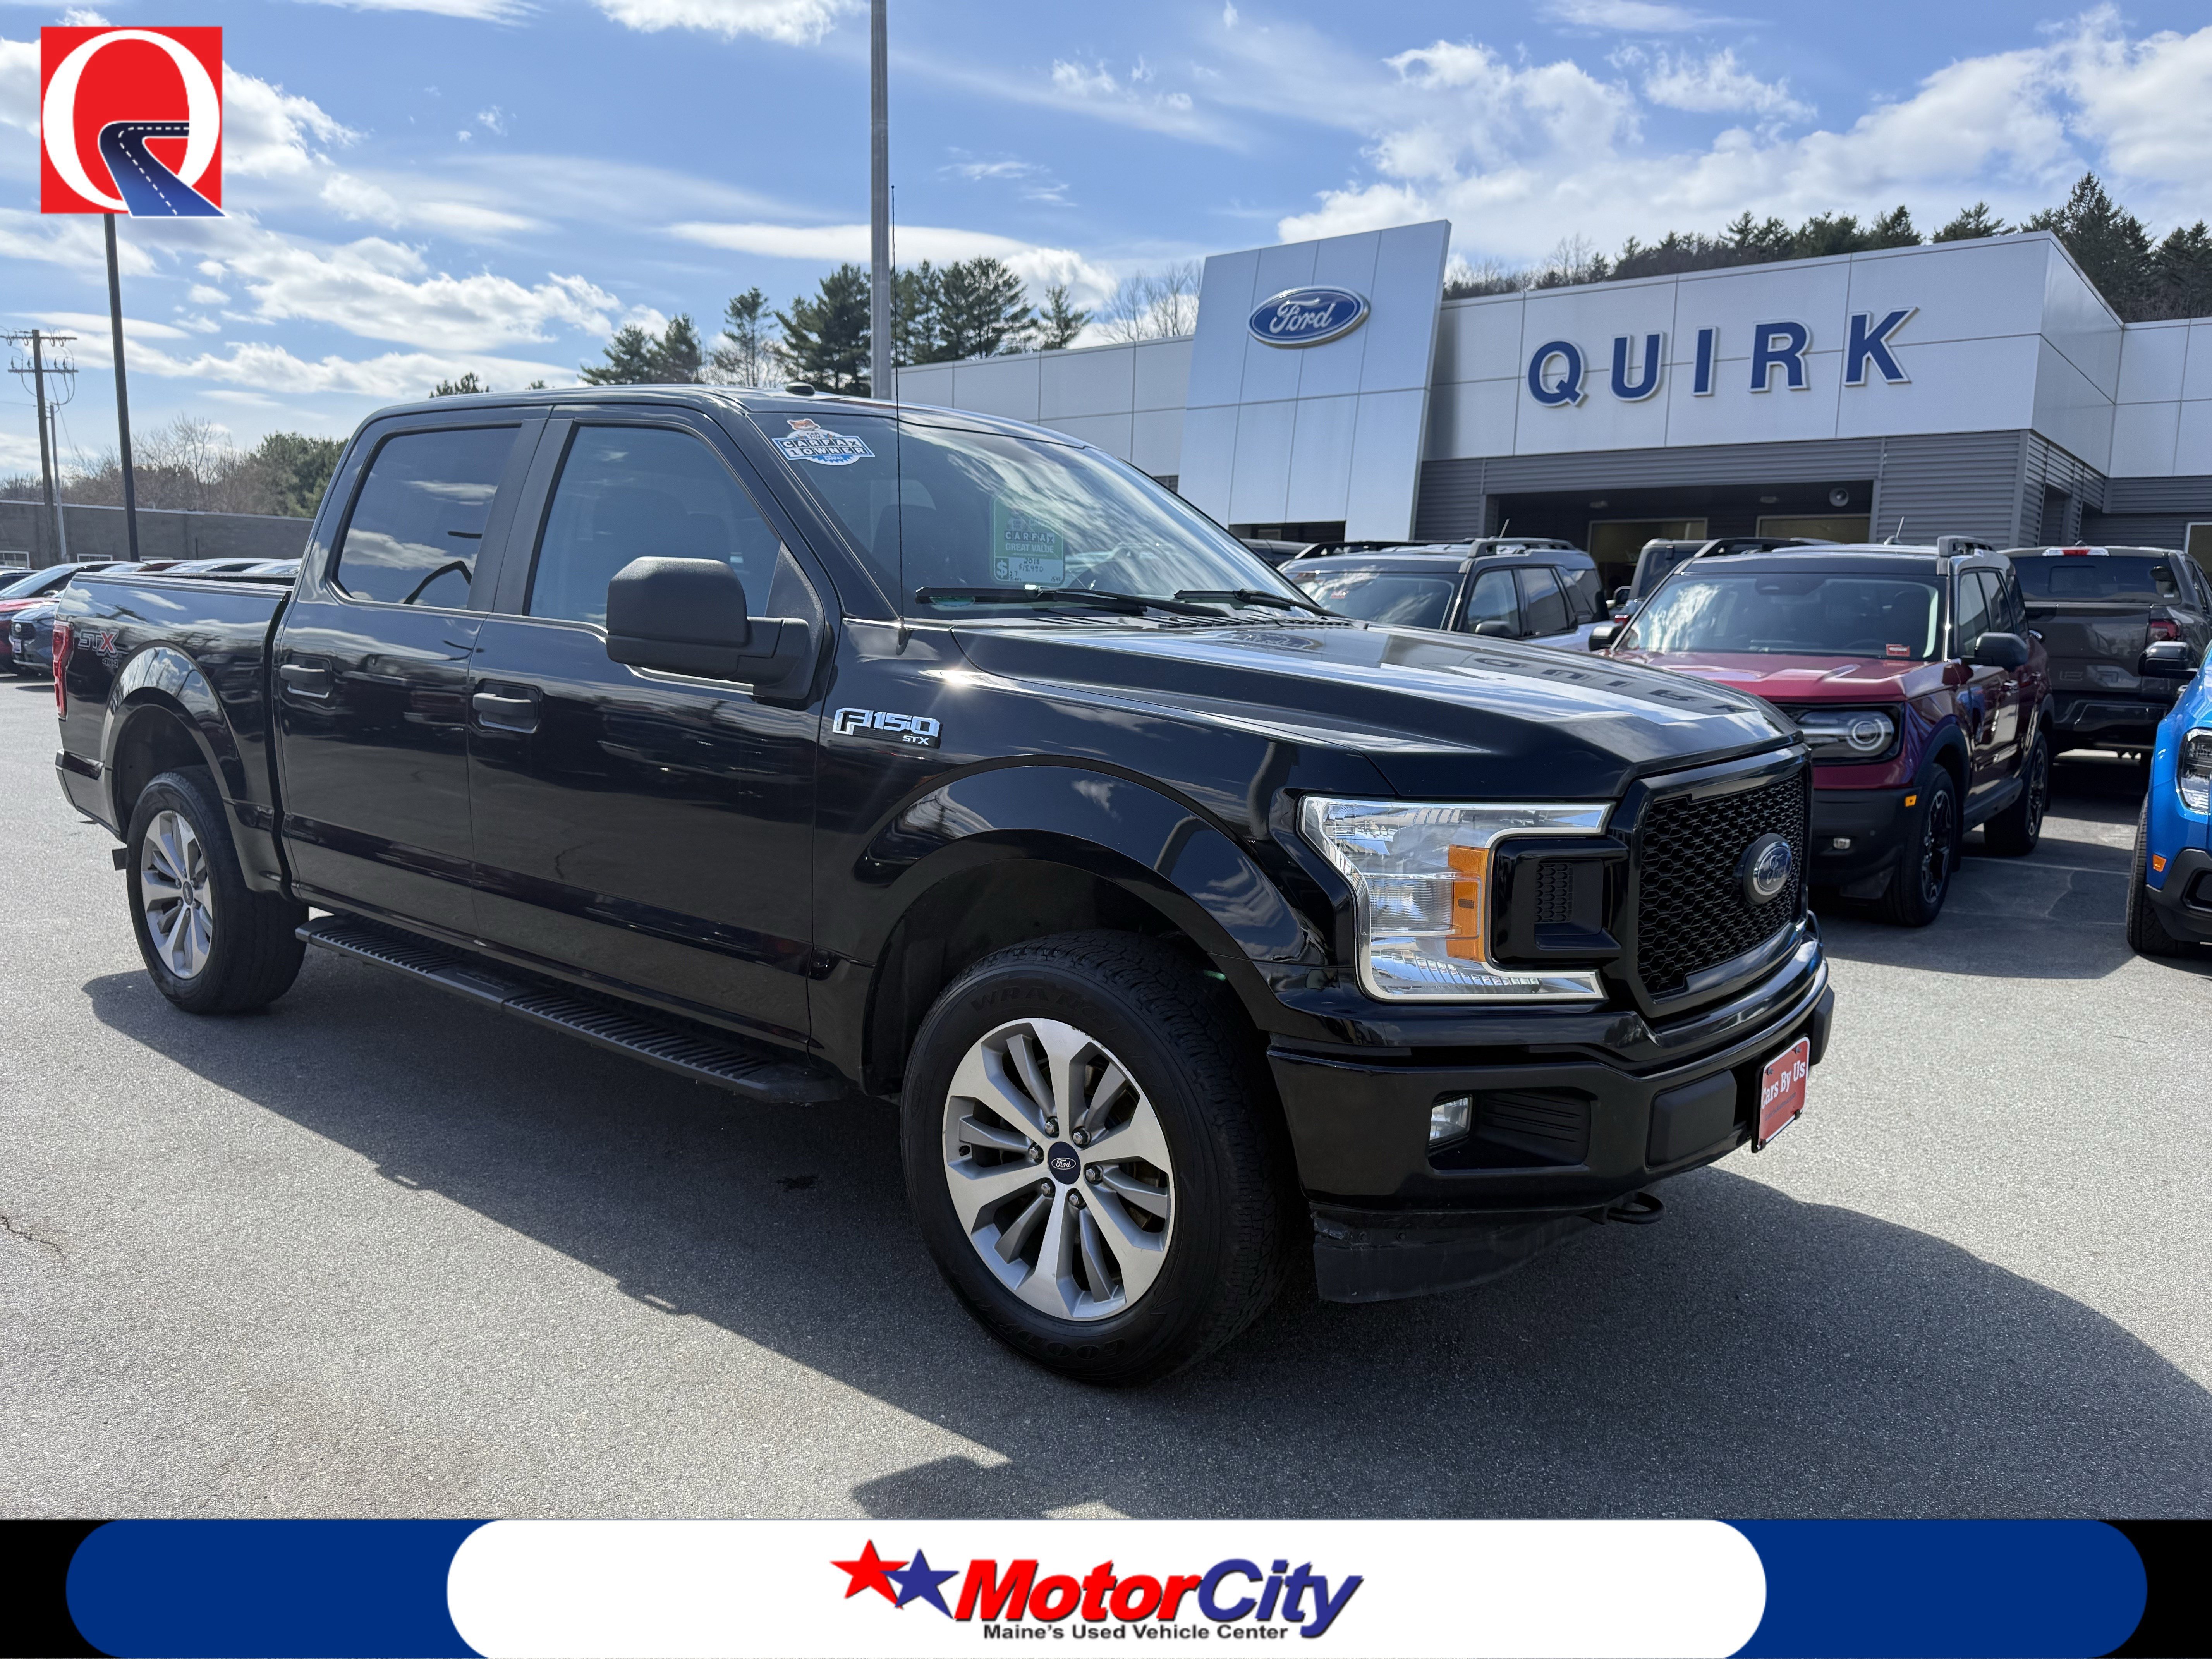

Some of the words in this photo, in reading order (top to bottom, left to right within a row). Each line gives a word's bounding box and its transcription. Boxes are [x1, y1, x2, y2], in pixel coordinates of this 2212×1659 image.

[1269, 297, 1336, 334] Ford
[1526, 306, 1919, 408] QUIRK
[782, 439, 860, 448] CARFAX
[1005, 531, 1054, 543] CARFAX
[1005, 543, 1030, 551] GREAT
[1032, 544, 1054, 553] VALUE
[78, 629, 119, 658] STX
[902, 735, 929, 745] STX
[1761, 1081, 1779, 1109] Cars
[1780, 1070, 1792, 1092] By
[1793, 1060, 1805, 1082] Us
[1056, 1159, 1071, 1168] Ford
